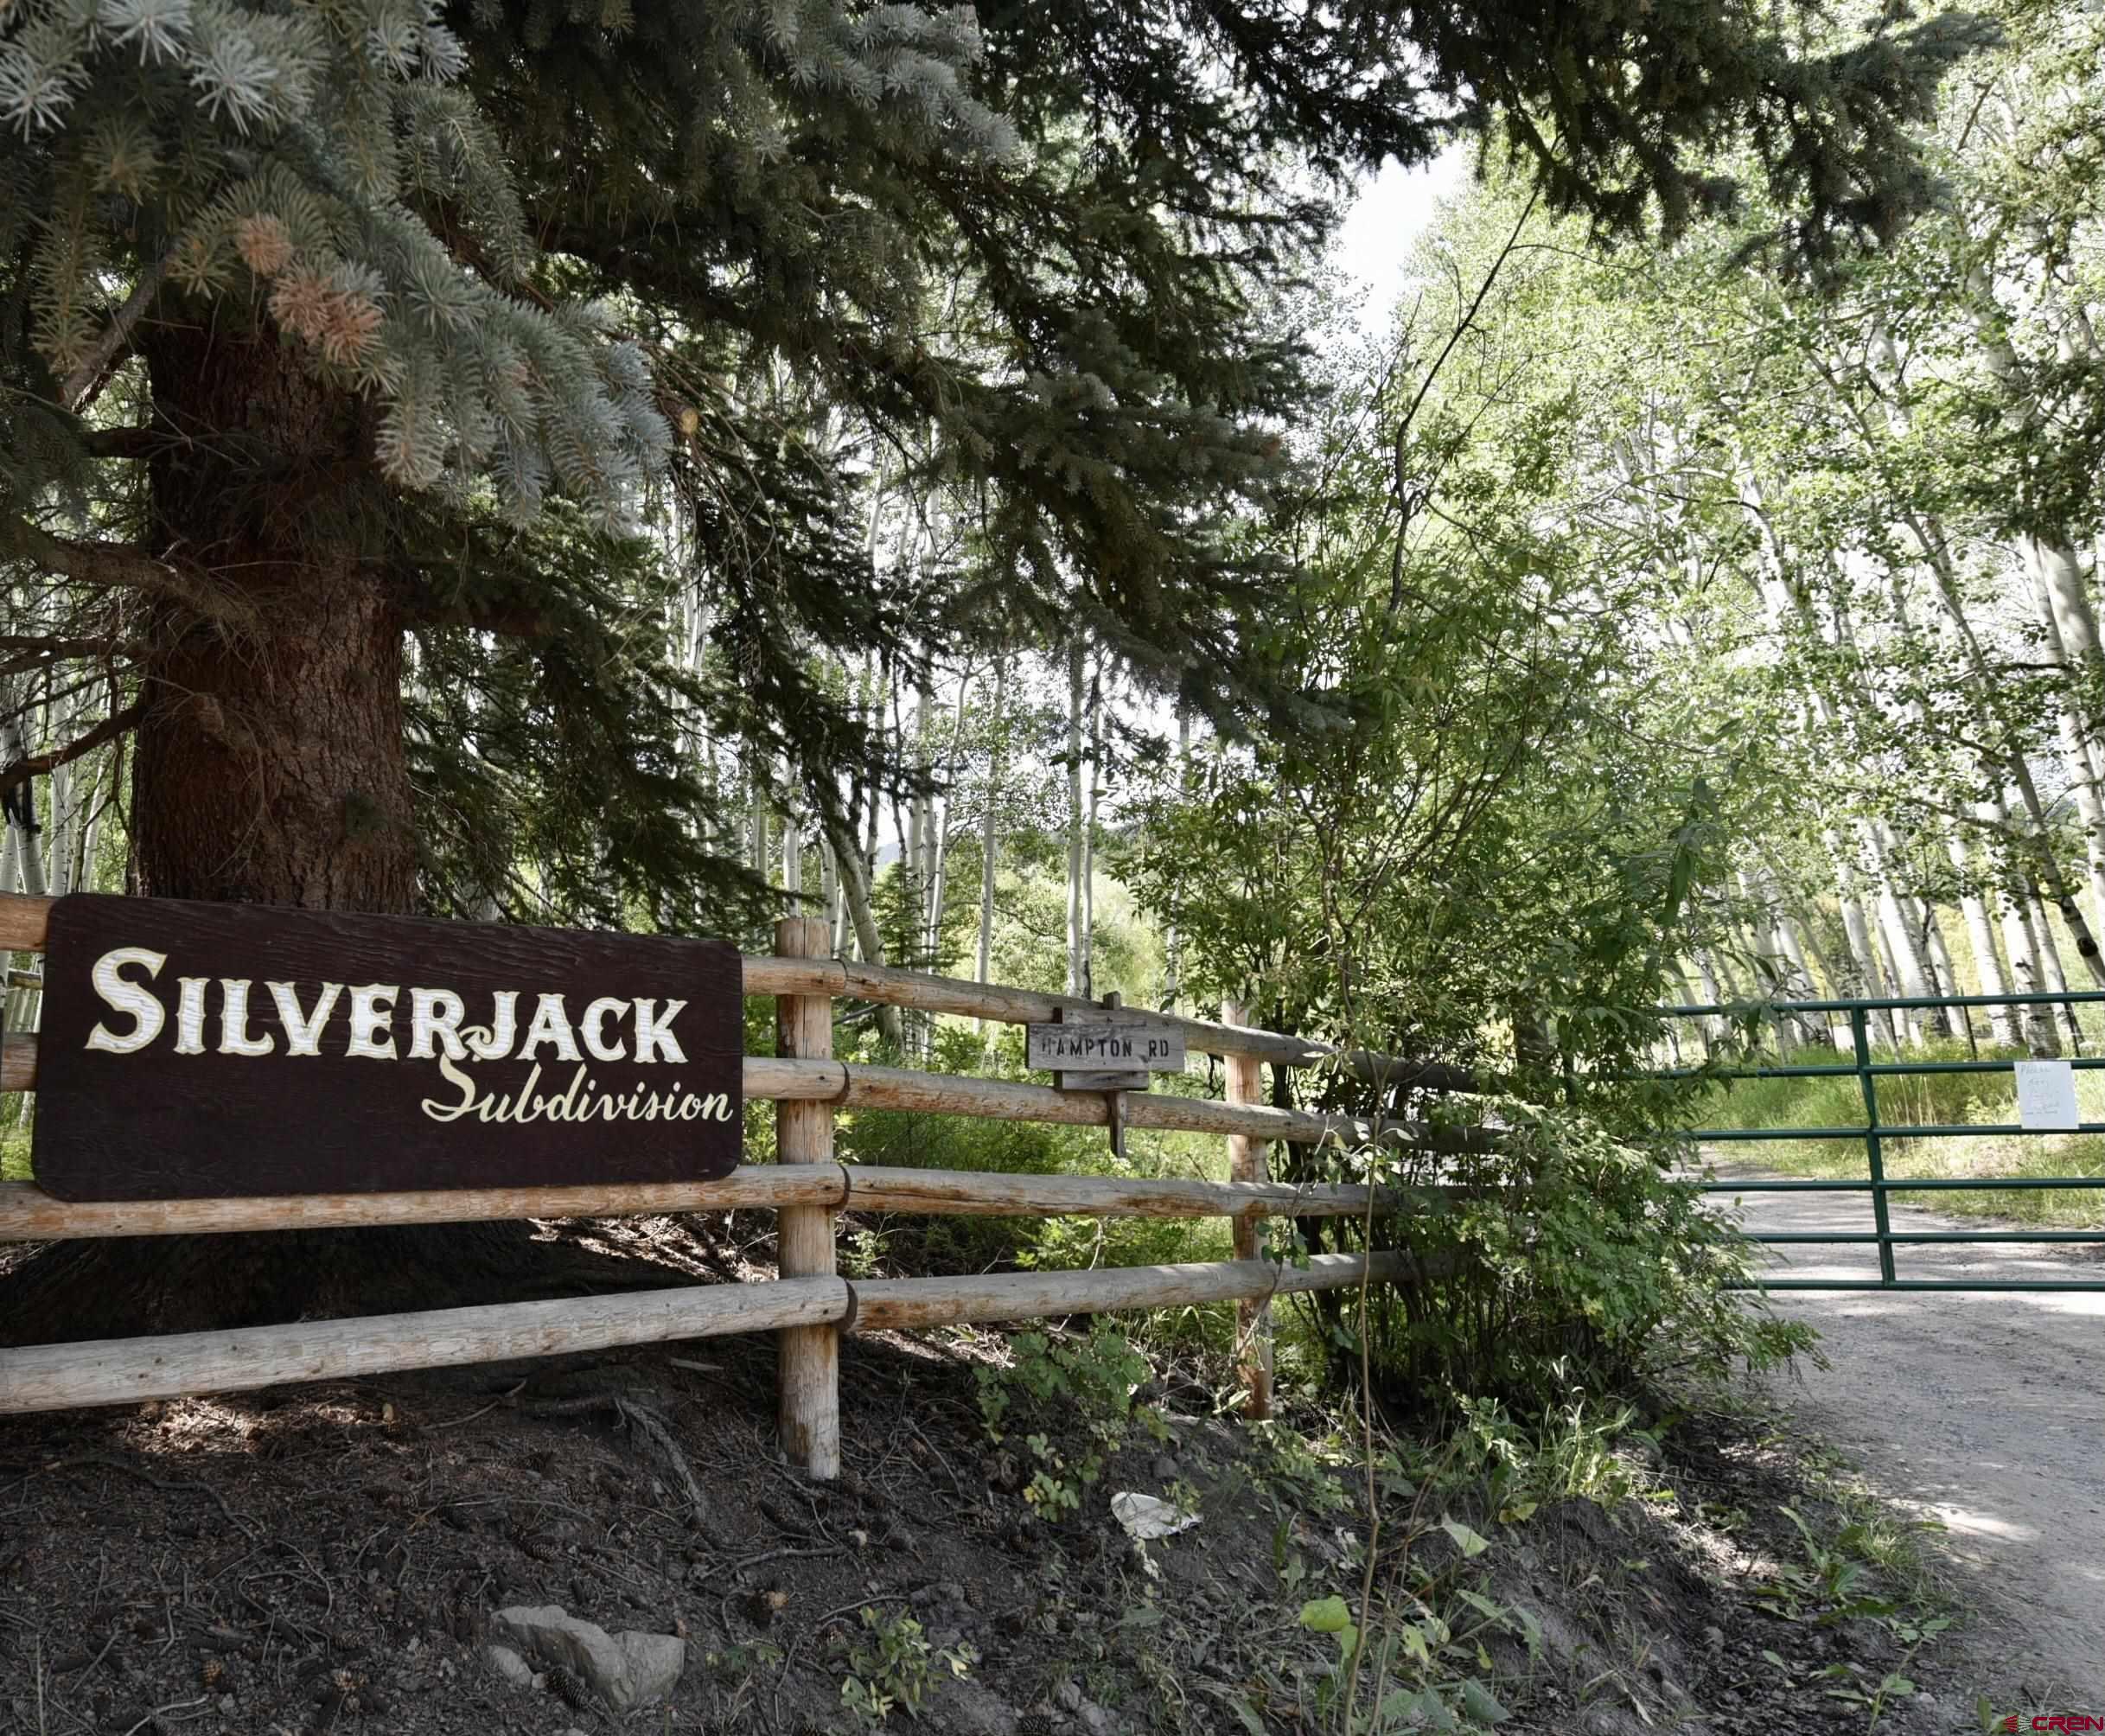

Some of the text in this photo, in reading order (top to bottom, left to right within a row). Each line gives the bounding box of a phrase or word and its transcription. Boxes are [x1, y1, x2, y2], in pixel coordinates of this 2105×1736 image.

[85, 946, 689, 1063] SILVERJACK
[1149, 1039, 1170, 1057] RD
[422, 1056, 733, 1122] Subdivision
